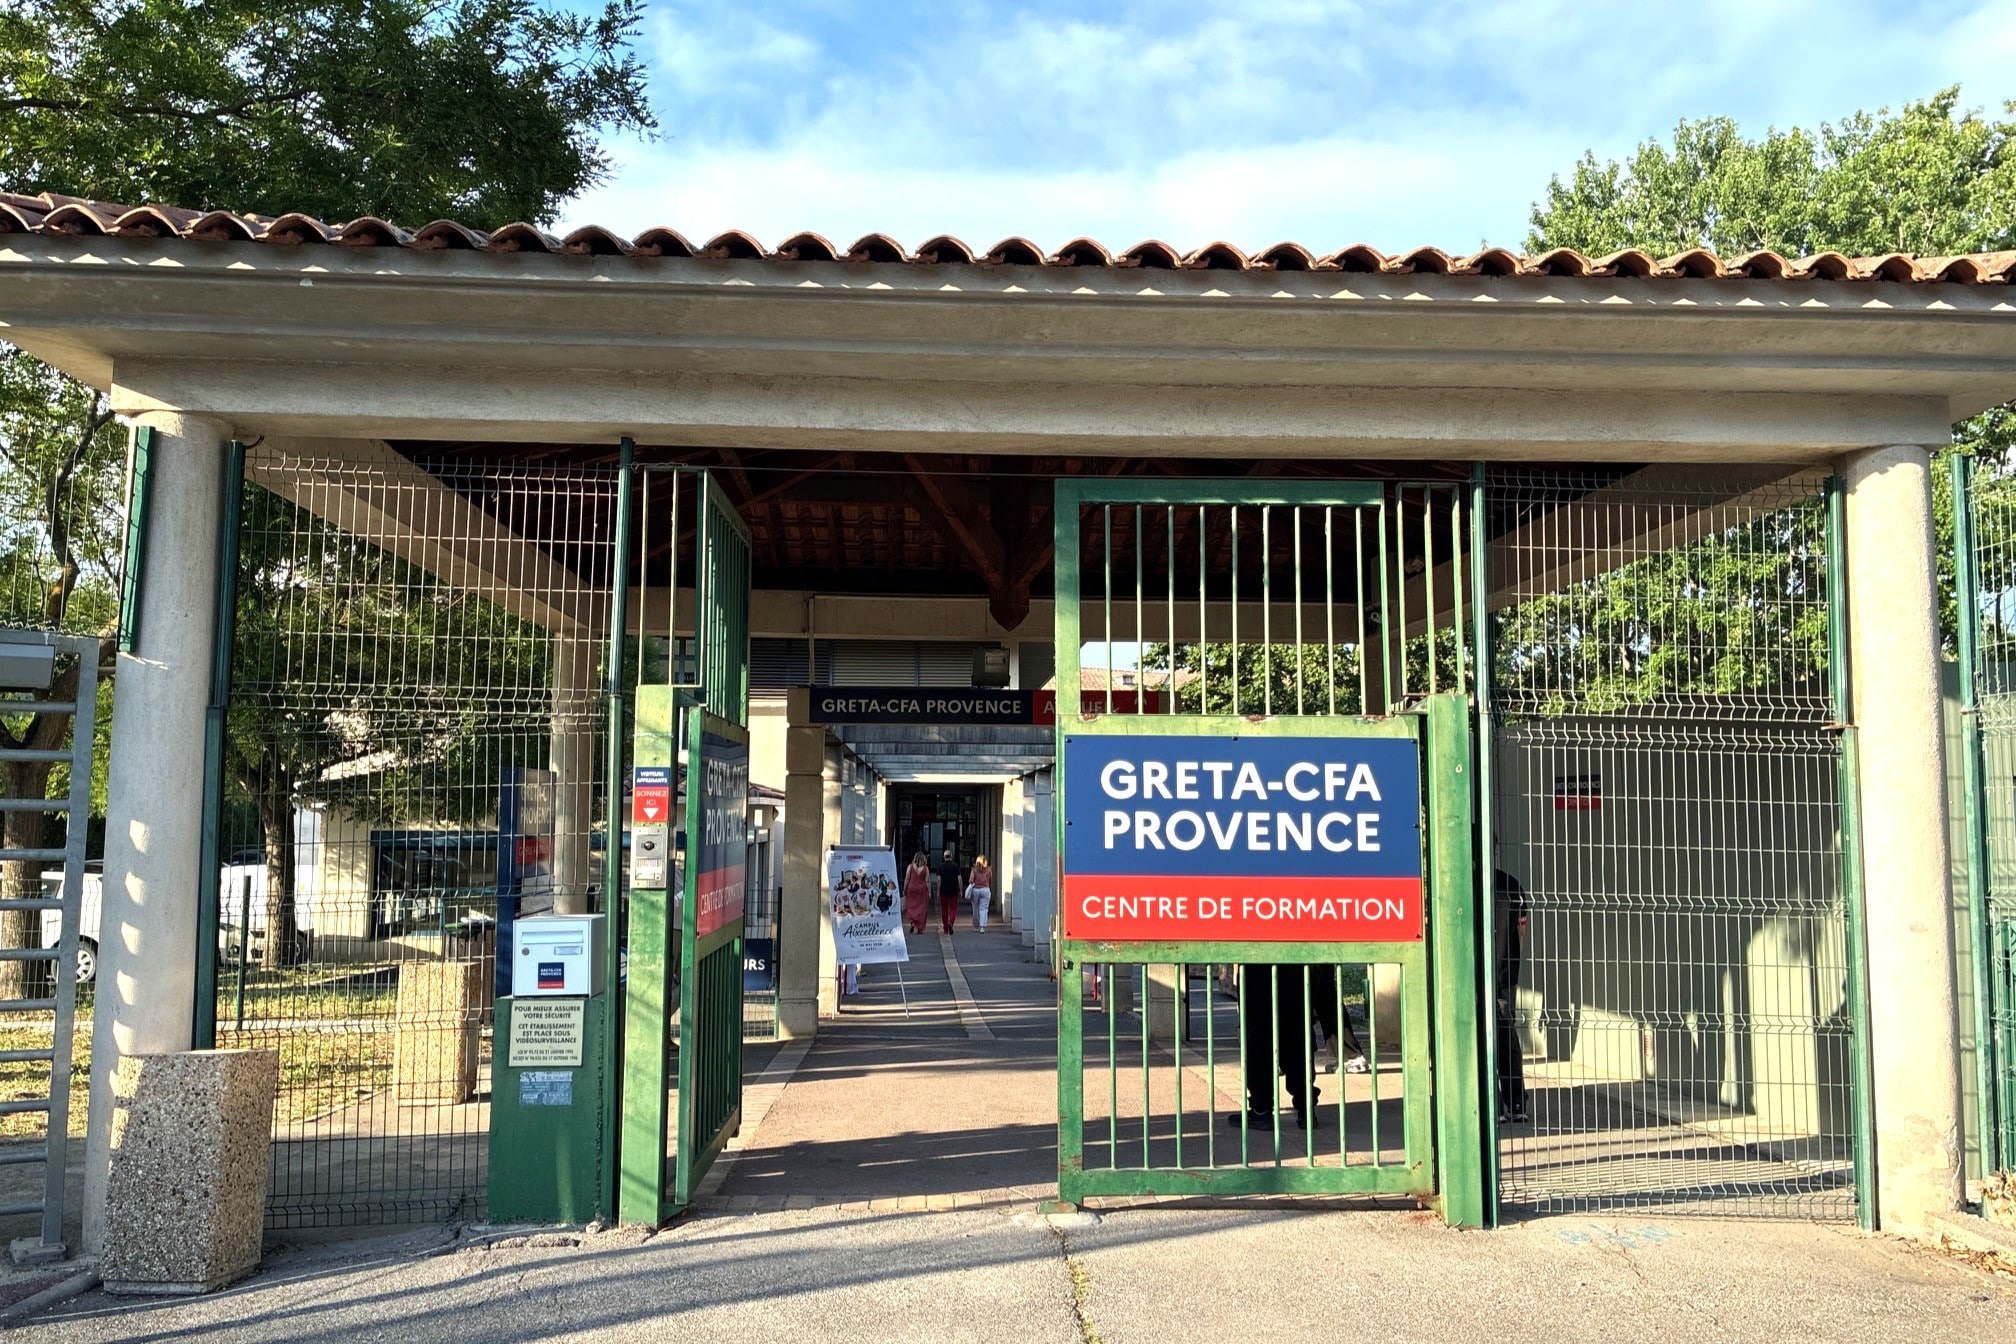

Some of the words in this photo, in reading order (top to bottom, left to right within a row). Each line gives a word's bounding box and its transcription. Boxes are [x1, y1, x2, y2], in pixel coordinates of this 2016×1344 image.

[822, 699, 920, 713] GRETA-CFA
[927, 700, 1021, 714] PROVENCE
[1100, 760, 1382, 801] GRETA-CFA
[706, 808, 742, 845] PROVENCE
[1104, 811, 1380, 851] PROVENCE
[1082, 895, 1187, 918] CENTRE
[1199, 897, 1232, 919] DE
[1243, 897, 1404, 920] FORMATION
